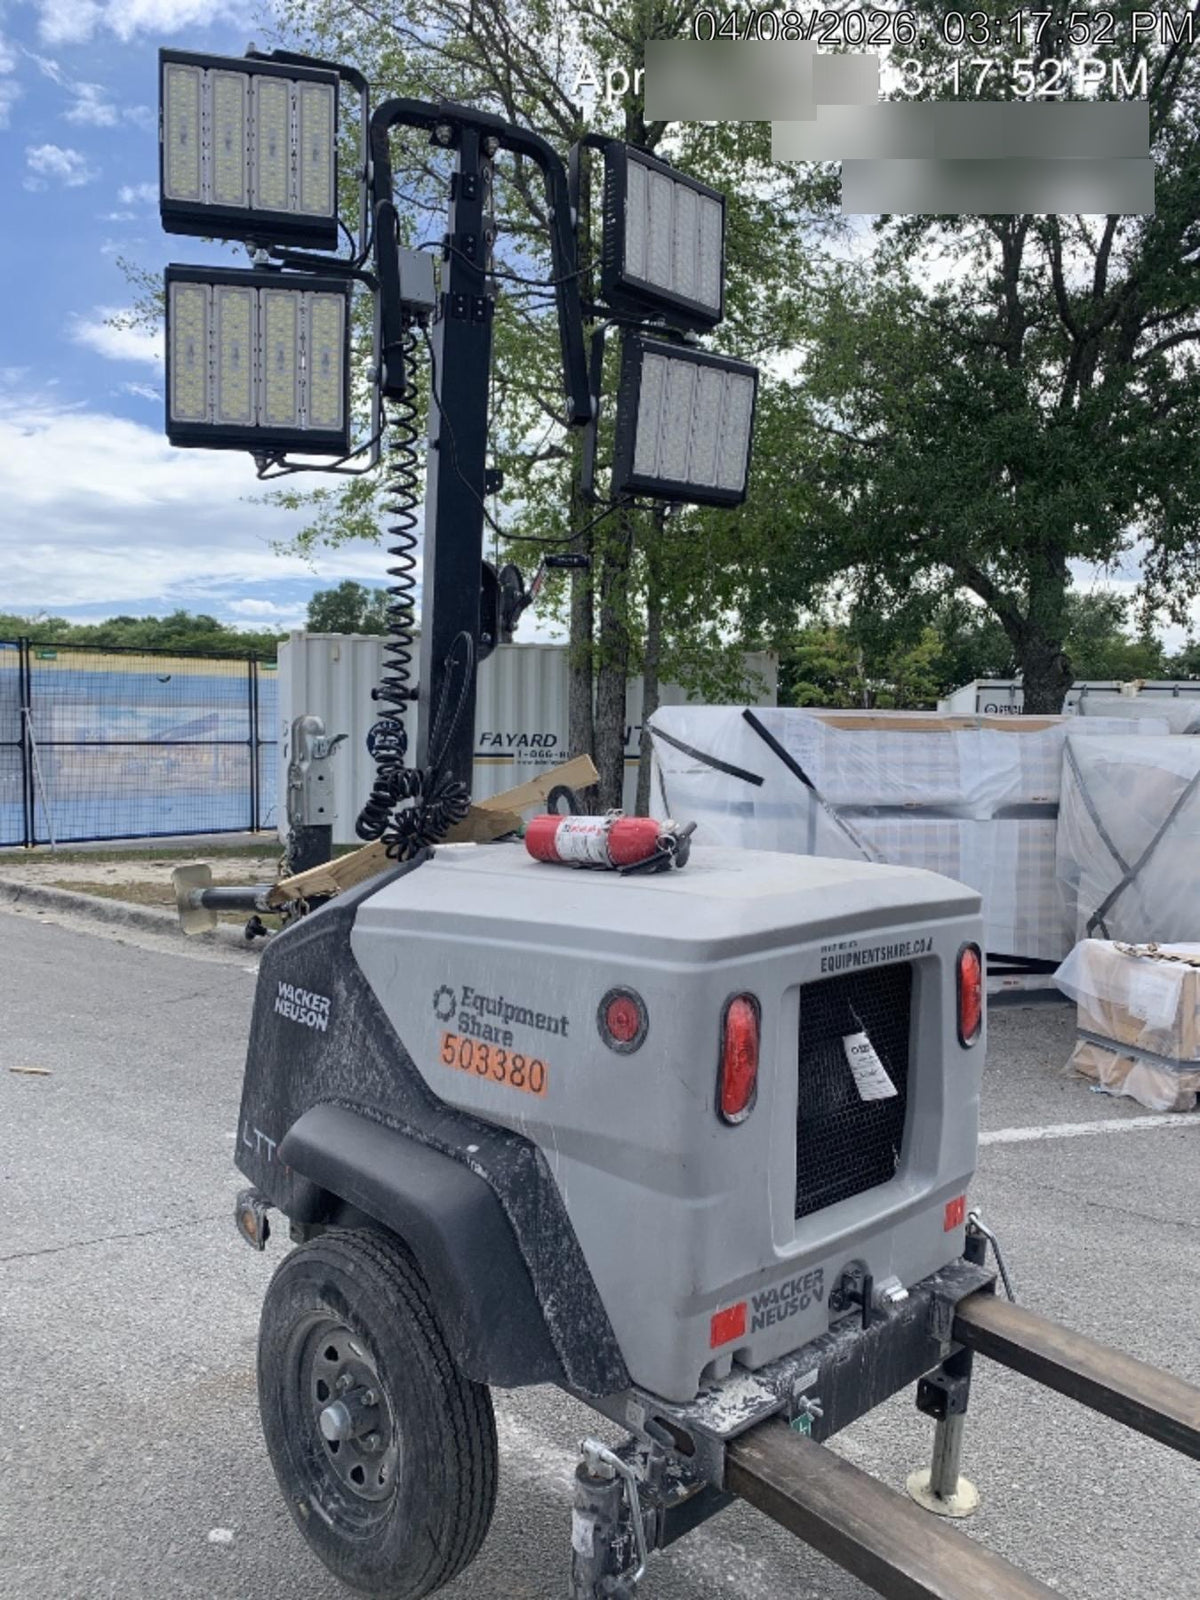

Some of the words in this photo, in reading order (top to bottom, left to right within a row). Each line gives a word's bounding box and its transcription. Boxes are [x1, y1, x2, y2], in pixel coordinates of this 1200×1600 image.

[479, 732, 557, 748] FAYARD
[274, 996, 329, 1032] NEUSON
[278, 980, 331, 1016] WACKER
[461, 985, 570, 1037] Equipment
[458, 1011, 514, 1047] Share
[442, 1033, 545, 1093] 503380
[751, 1266, 824, 1313] WACKER
